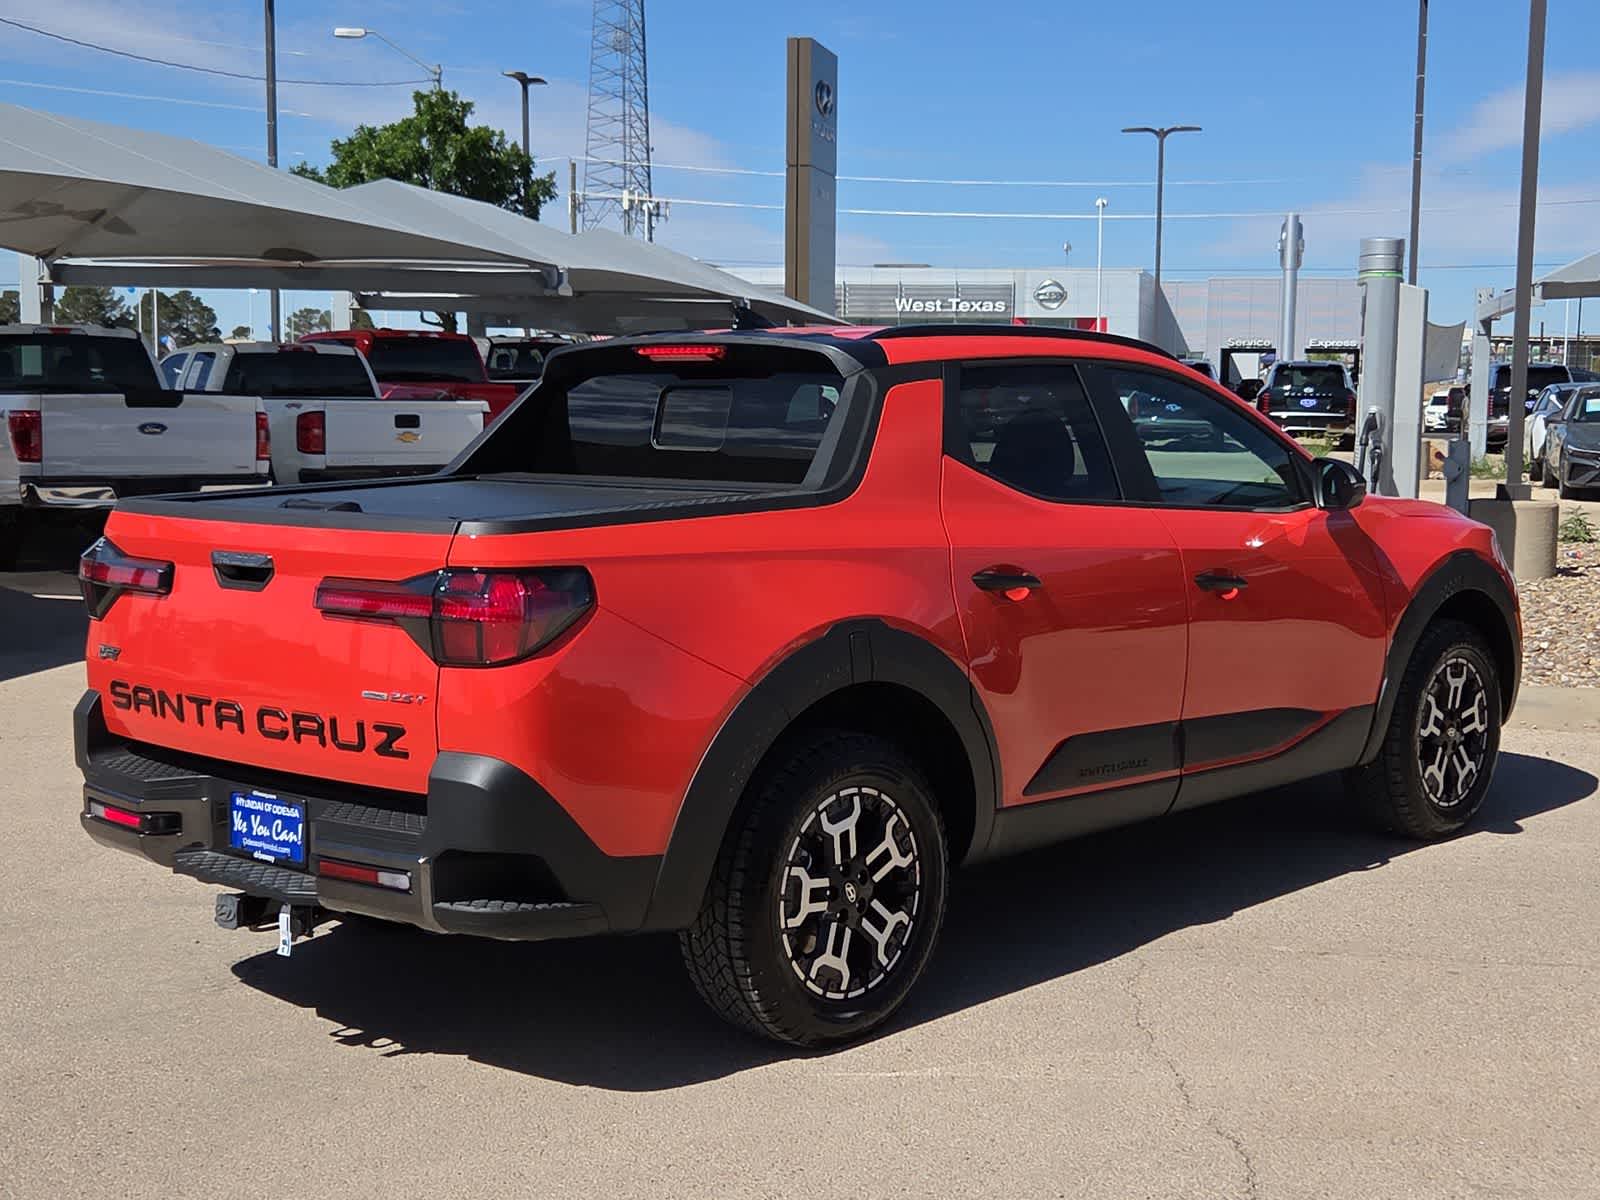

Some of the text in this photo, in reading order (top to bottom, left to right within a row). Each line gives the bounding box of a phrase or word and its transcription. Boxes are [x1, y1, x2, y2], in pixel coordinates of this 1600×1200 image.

[895, 298, 1006, 312] West Texas
[1227, 337, 1272, 348] Service
[1309, 339, 1357, 349] Express
[110, 679, 410, 760] SANTA CRUZ
[235, 796, 300, 818] HYUNDAI OF ODESSA
[232, 810, 303, 845] Yes You Can!
